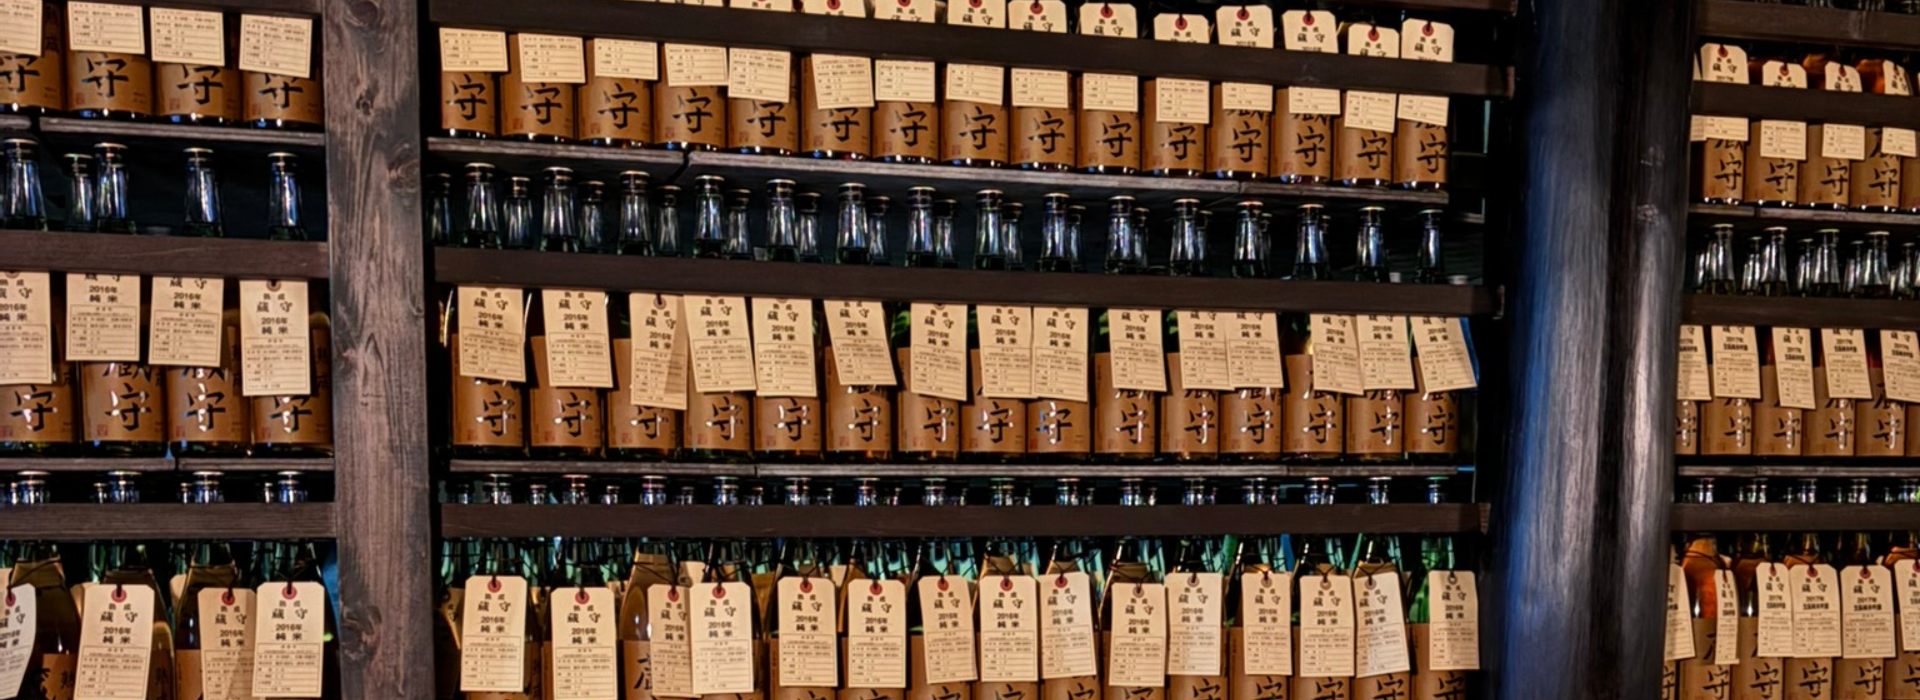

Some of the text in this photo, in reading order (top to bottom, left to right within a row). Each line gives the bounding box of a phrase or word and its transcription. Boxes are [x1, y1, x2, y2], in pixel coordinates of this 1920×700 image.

[82, 56, 129, 99] 守
[177, 65, 222, 105] 守
[258, 73, 303, 109] 守
[446, 74, 487, 121] 守
[521, 83, 562, 124] 守
[598, 83, 639, 129] 守
[672, 87, 712, 134] 守
[746, 101, 786, 138] 守
[821, 107, 860, 142] 守
[890, 102, 928, 146] 守
[959, 106, 997, 150] 守
[1028, 110, 1065, 154] 守
[1096, 114, 1132, 158] 守
[1161, 122, 1196, 161] 守
[1227, 121, 1261, 163] 守
[1296, 126, 1325, 167] 守
[1357, 130, 1387, 170] 守
[1417, 133, 1447, 173] 守
[1714, 153, 1742, 190] 守
[1765, 159, 1795, 193] 守
[1820, 160, 1848, 195] 守
[1869, 162, 1898, 198] 守
[0, 303, 27, 311] 2016年
[89, 285, 117, 293] 2016年
[174, 292, 201, 300] 2016年
[261, 317, 288, 325] 2016年
[478, 311, 503, 321] 2016年
[706, 320, 729, 328] 2016年
[927, 330, 949, 339] 2016年
[1049, 331, 1071, 340] 2016年
[649, 331, 672, 341] 2016年
[10, 385, 53, 432] 守
[105, 383, 151, 431] 守
[476, 391, 516, 437] 守
[554, 392, 592, 437] 守
[706, 396, 743, 441] 守
[774, 397, 811, 442] 守
[848, 399, 881, 442] 守
[977, 402, 1013, 443] 守
[1115, 403, 1149, 444] 守
[1241, 403, 1273, 444] 守
[1302, 403, 1336, 444] 守
[1421, 405, 1454, 445] 守
[103, 627, 131, 635] 2016年
[220, 629, 244, 637] 2016年
[275, 623, 302, 631] 2016年
[665, 624, 684, 632] 2016年
[708, 621, 732, 629] 2016年
[795, 615, 818, 623] 2016年
[1702, 662, 1730, 700] 守
[1751, 662, 1779, 699] 守
[1800, 661, 1829, 697] 守
[1854, 662, 1882, 695] 守
